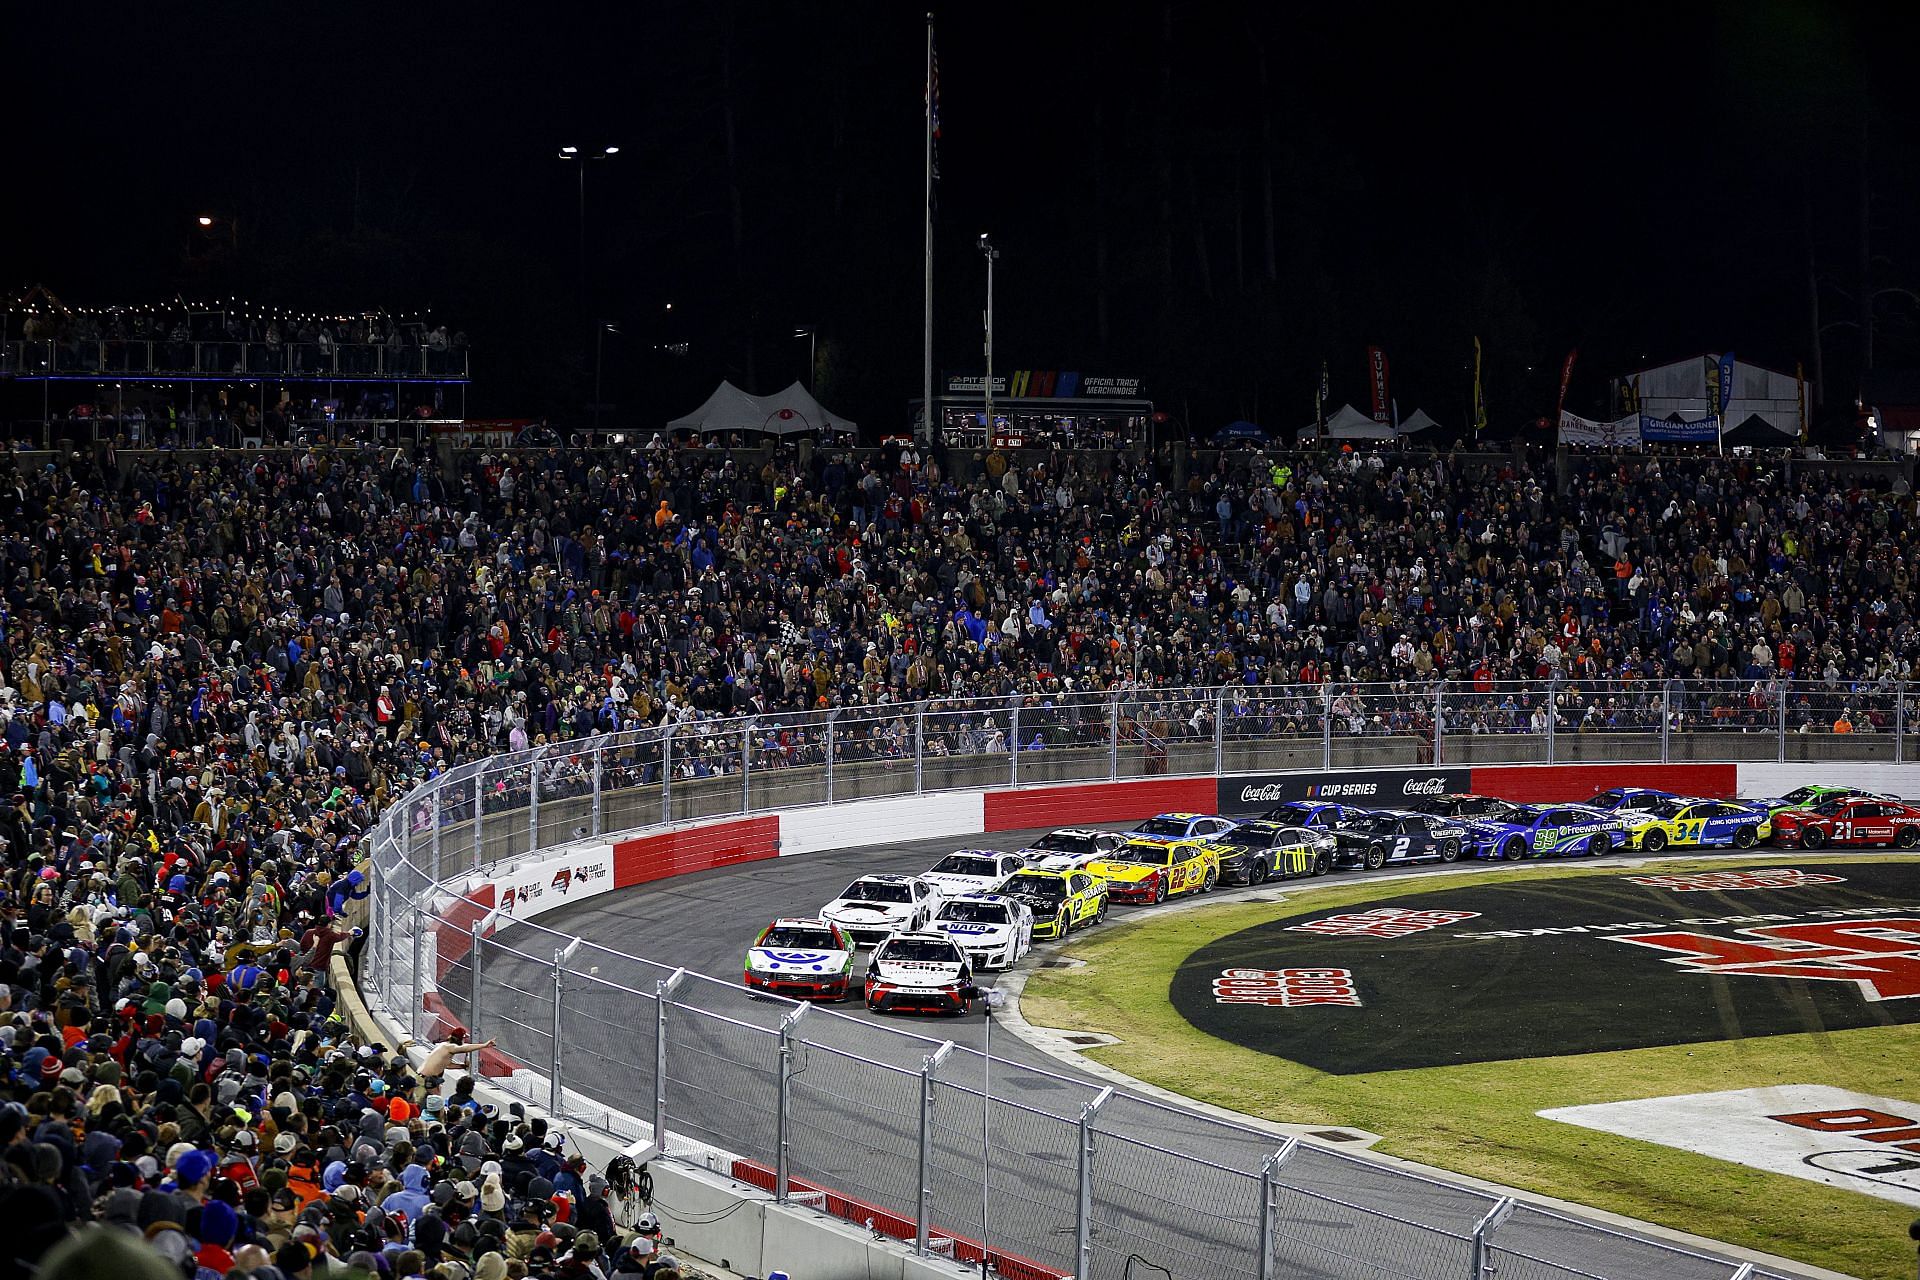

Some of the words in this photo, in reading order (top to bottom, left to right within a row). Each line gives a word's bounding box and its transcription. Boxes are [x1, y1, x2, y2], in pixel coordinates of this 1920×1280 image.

[979, 376, 1006, 384] SOP
[1085, 377, 1114, 386] OFFICIAL
[1117, 378, 1140, 387] TRACK
[1087, 386, 1137, 394] MERCHANDISE
[1650, 420, 1683, 429] GRECIAN
[1685, 420, 1718, 429] CORNER
[1240, 783, 1283, 801] Coca-Cola
[1321, 785, 1341, 795] CUP
[1342, 783, 1377, 795] SERIES
[1402, 777, 1446, 795] Coca-Cola
[1567, 822, 1616, 835] Freeway.com
[1674, 823, 1700, 841] 34
[1830, 821, 1851, 840] 21
[1392, 837, 1410, 857] 2
[1533, 828, 1559, 850] 99
[1273, 850, 1282, 871] 1
[1170, 868, 1186, 889] 22
[1072, 899, 1082, 921] 12
[948, 923, 987, 932] NAPA
